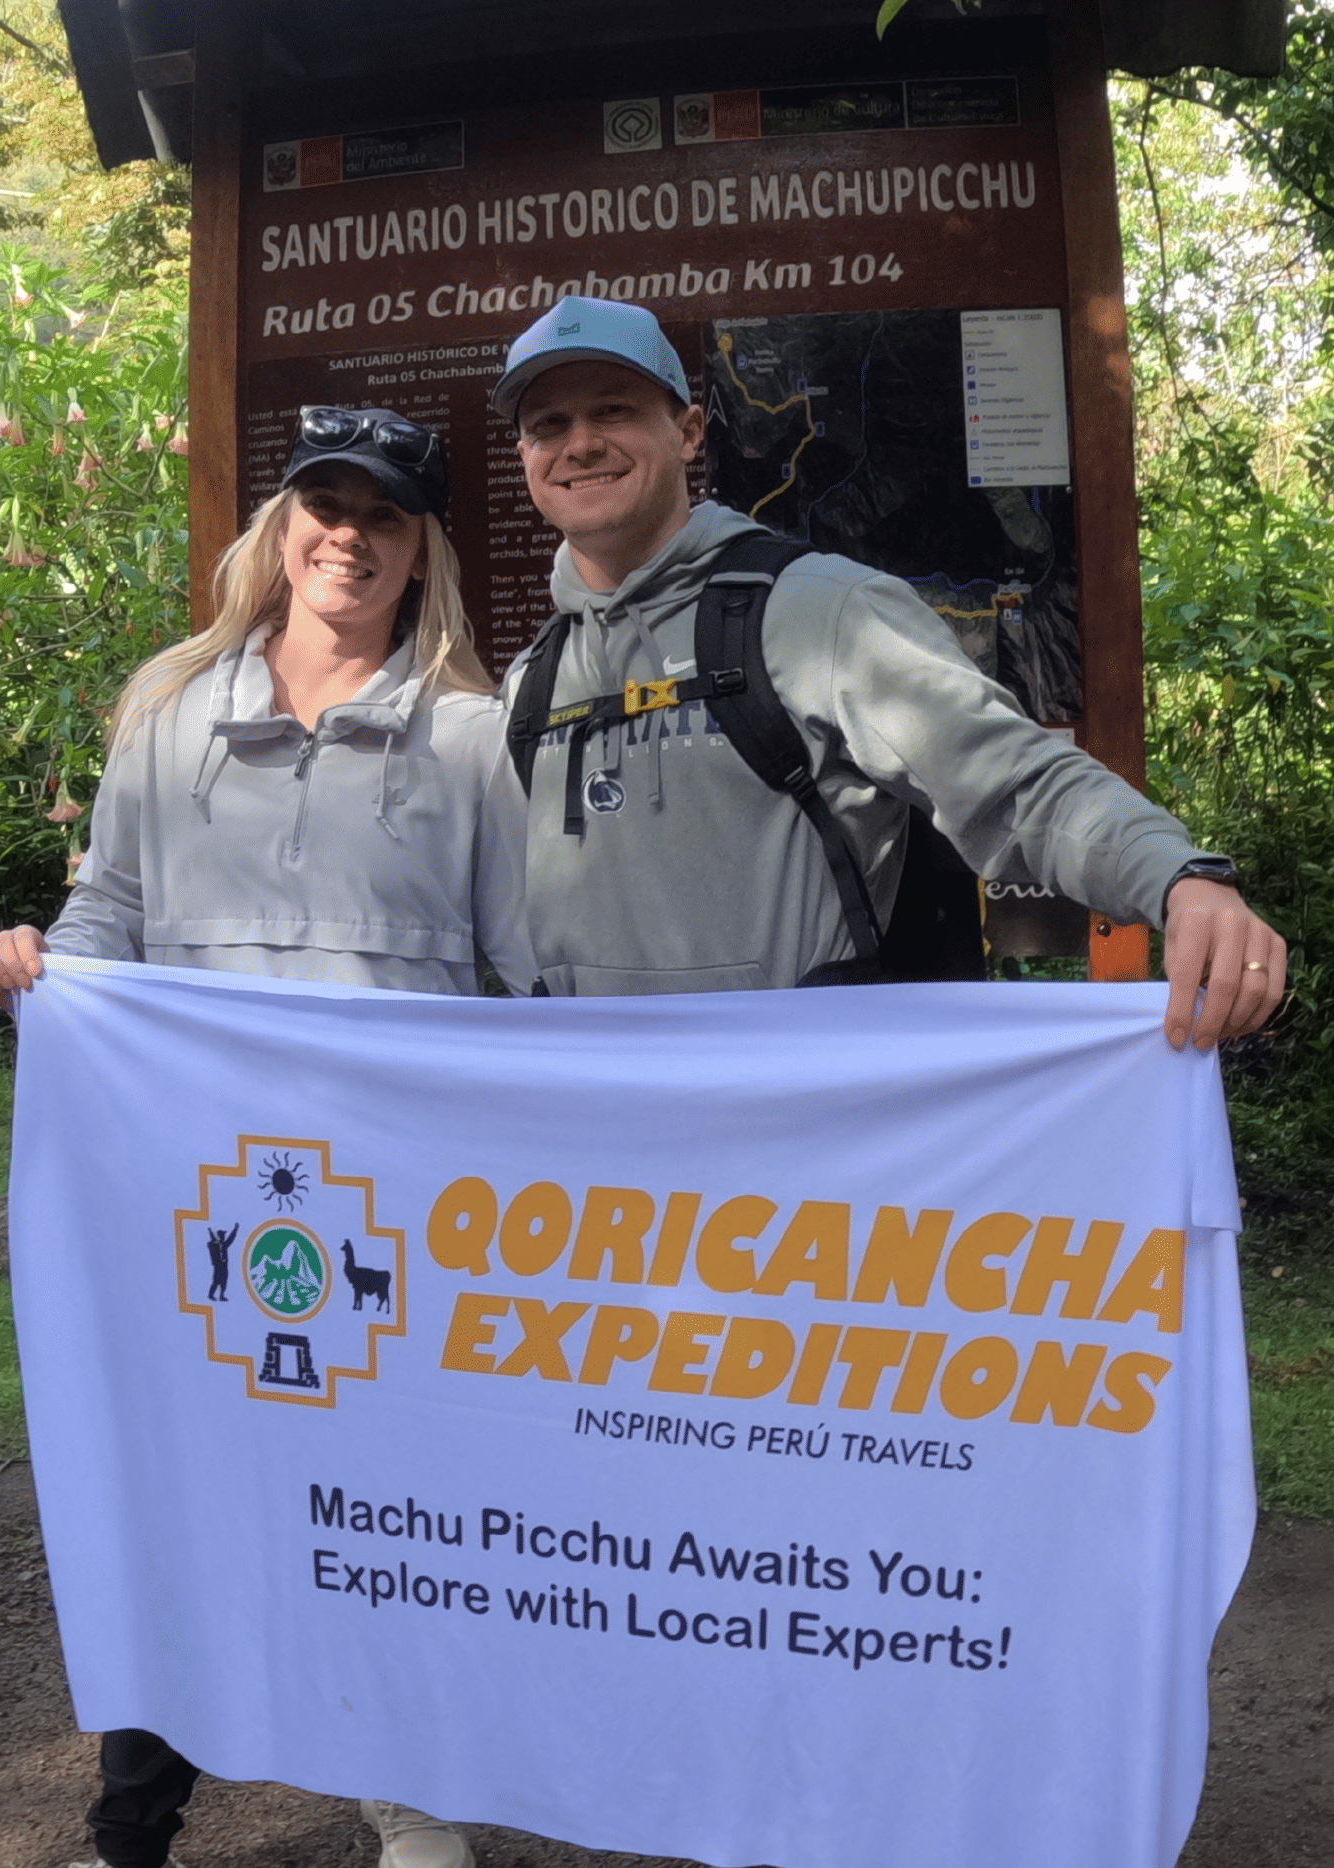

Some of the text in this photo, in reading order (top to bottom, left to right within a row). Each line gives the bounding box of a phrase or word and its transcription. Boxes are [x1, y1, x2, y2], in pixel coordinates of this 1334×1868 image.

[261, 160, 1036, 272] SANTUARIO HISTORICO DE MACHUPICCHU
[262, 252, 904, 337] Ruta 05 Chachabamba Km 104
[328, 352, 404, 371] SANTUARIO
[407, 346, 478, 363] HISTÓRICO
[481, 345, 498, 357] DE
[368, 362, 507, 386] Ruta 05 Chachabamb
[382, 397, 393, 407] de
[399, 396, 408, 406] la
[414, 394, 431, 404] Red
[438, 392, 450, 402] de
[248, 410, 273, 422] Usted
[248, 407, 450, 435] Caminos recorrido
[486, 431, 497, 441] of
[248, 438, 288, 449] cruzando
[486, 446, 519, 457] throug
[487, 474, 526, 486] product
[488, 489, 514, 501] point
[516, 488, 528, 498] to
[488, 502, 535, 515] be able
[489, 519, 534, 530] evidence,
[489, 532, 557, 545] and a great
[489, 548, 528, 560] orchids,
[490, 575, 515, 585] Then
[519, 574, 538, 585] you
[491, 605, 514, 615] view
[515, 602, 527, 613] of
[530, 601, 546, 612] the
[491, 619, 503, 630] of
[505, 618, 522, 629] the
[492, 635, 523, 646] snowy
[427, 1176, 1185, 1333] QORICANCHA
[441, 1294, 1170, 1433] EXPEDITIONS
[574, 1407, 975, 1472] INSPIRING PERÚ TRAVELS
[309, 1483, 983, 1604] Machu Picchu Awaits You:
[312, 1548, 1012, 1672] Explore with Local Experts!
